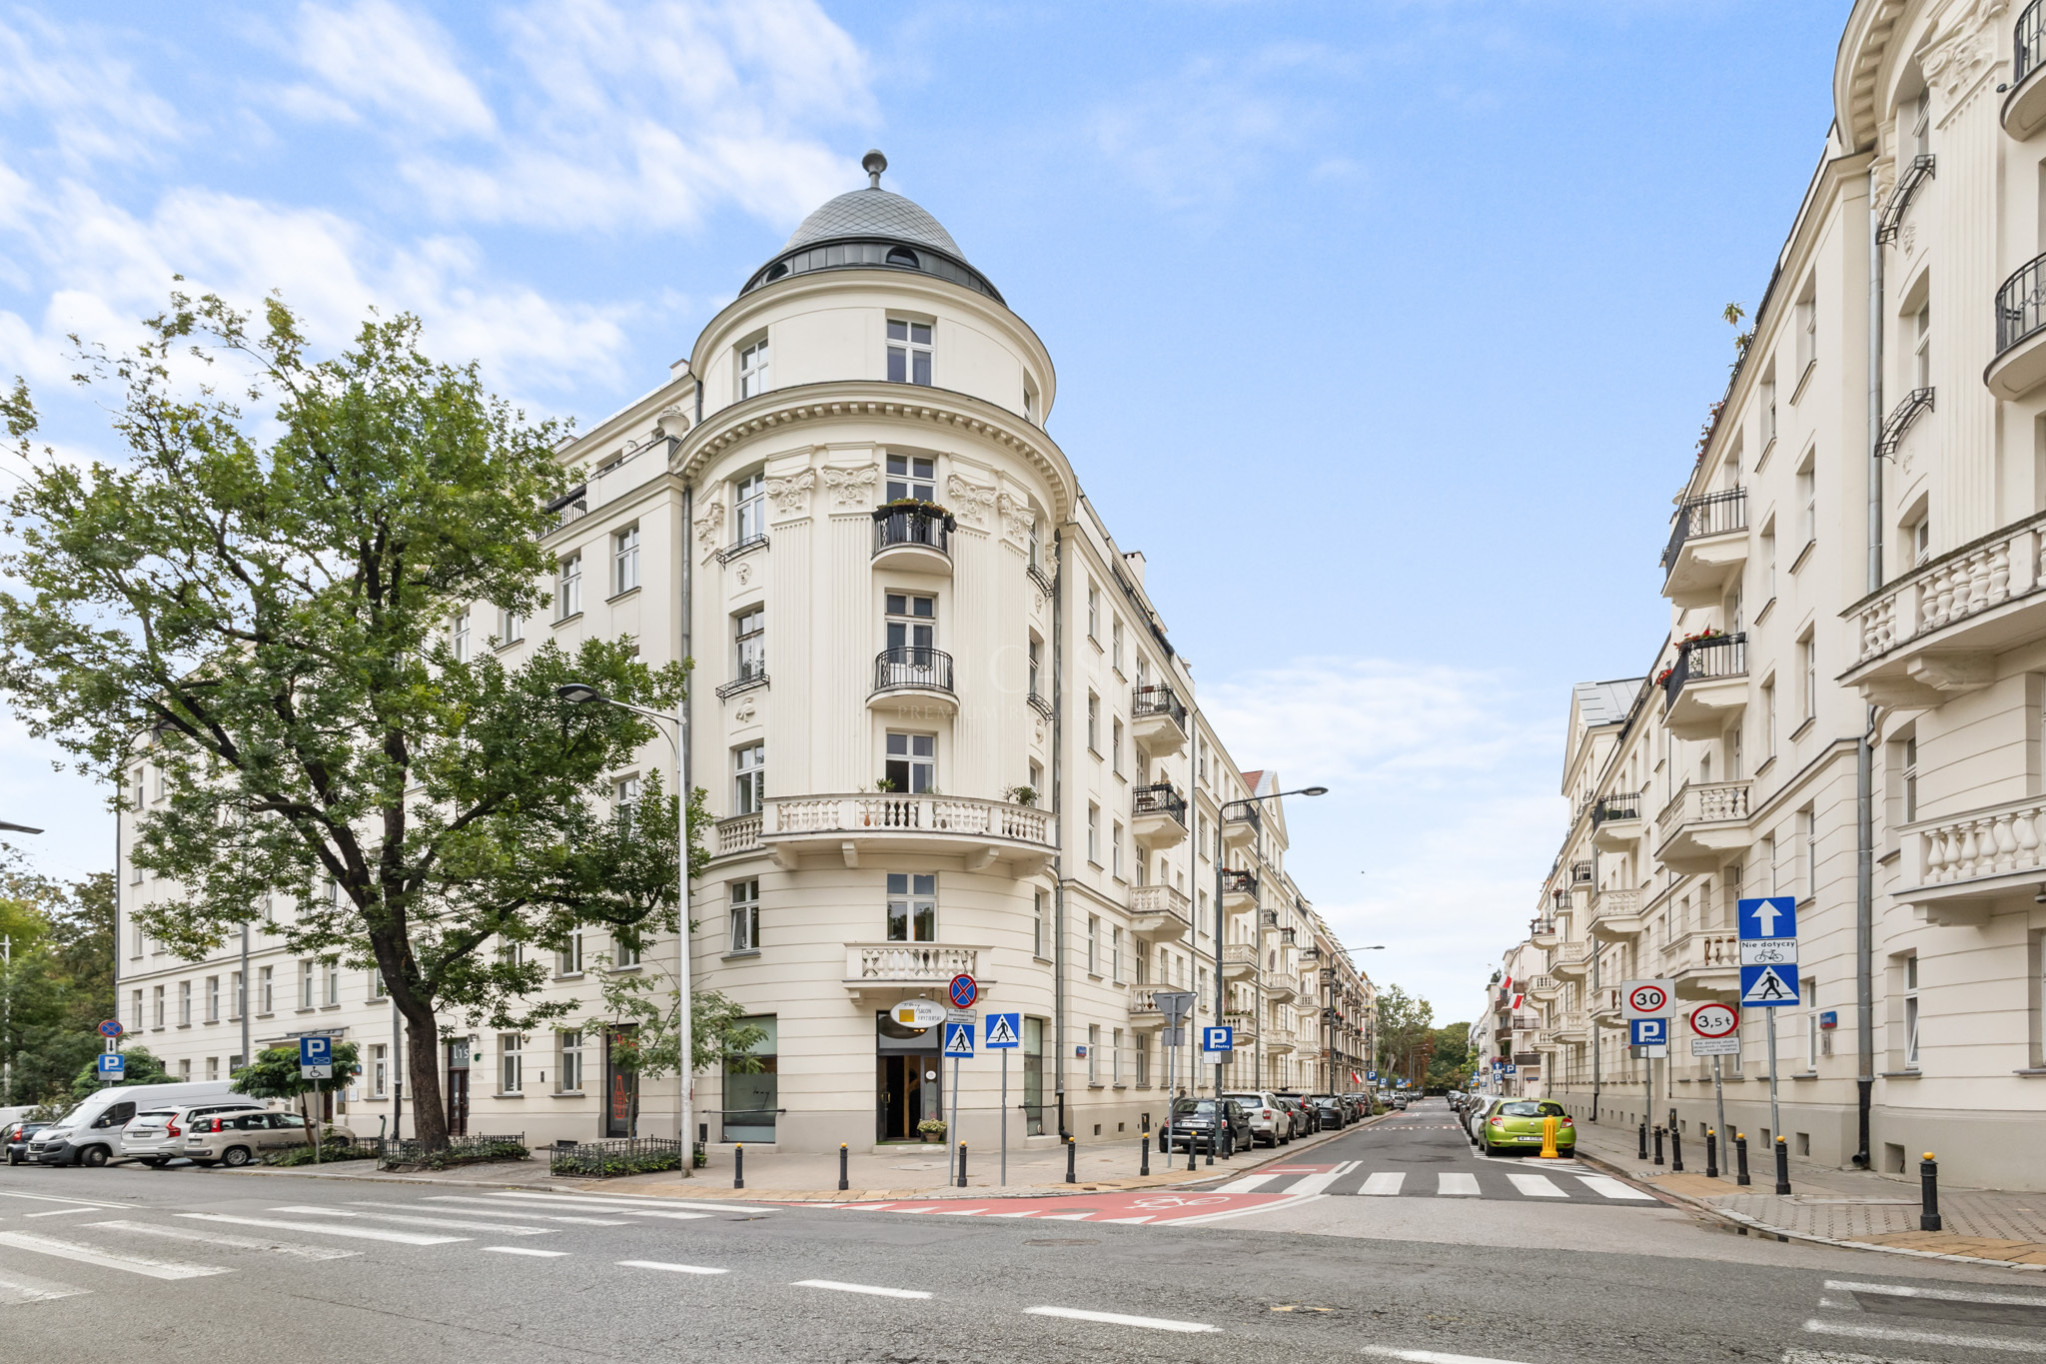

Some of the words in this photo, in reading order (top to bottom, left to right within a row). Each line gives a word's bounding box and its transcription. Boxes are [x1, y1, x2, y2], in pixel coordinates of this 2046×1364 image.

[1760, 941, 1795, 949] dotyczy
[1636, 992, 1661, 1006] 30
[1210, 1029, 1227, 1049] P
[1638, 1021, 1660, 1043] P
[307, 1039, 325, 1058] P
[104, 1056, 120, 1070] P
